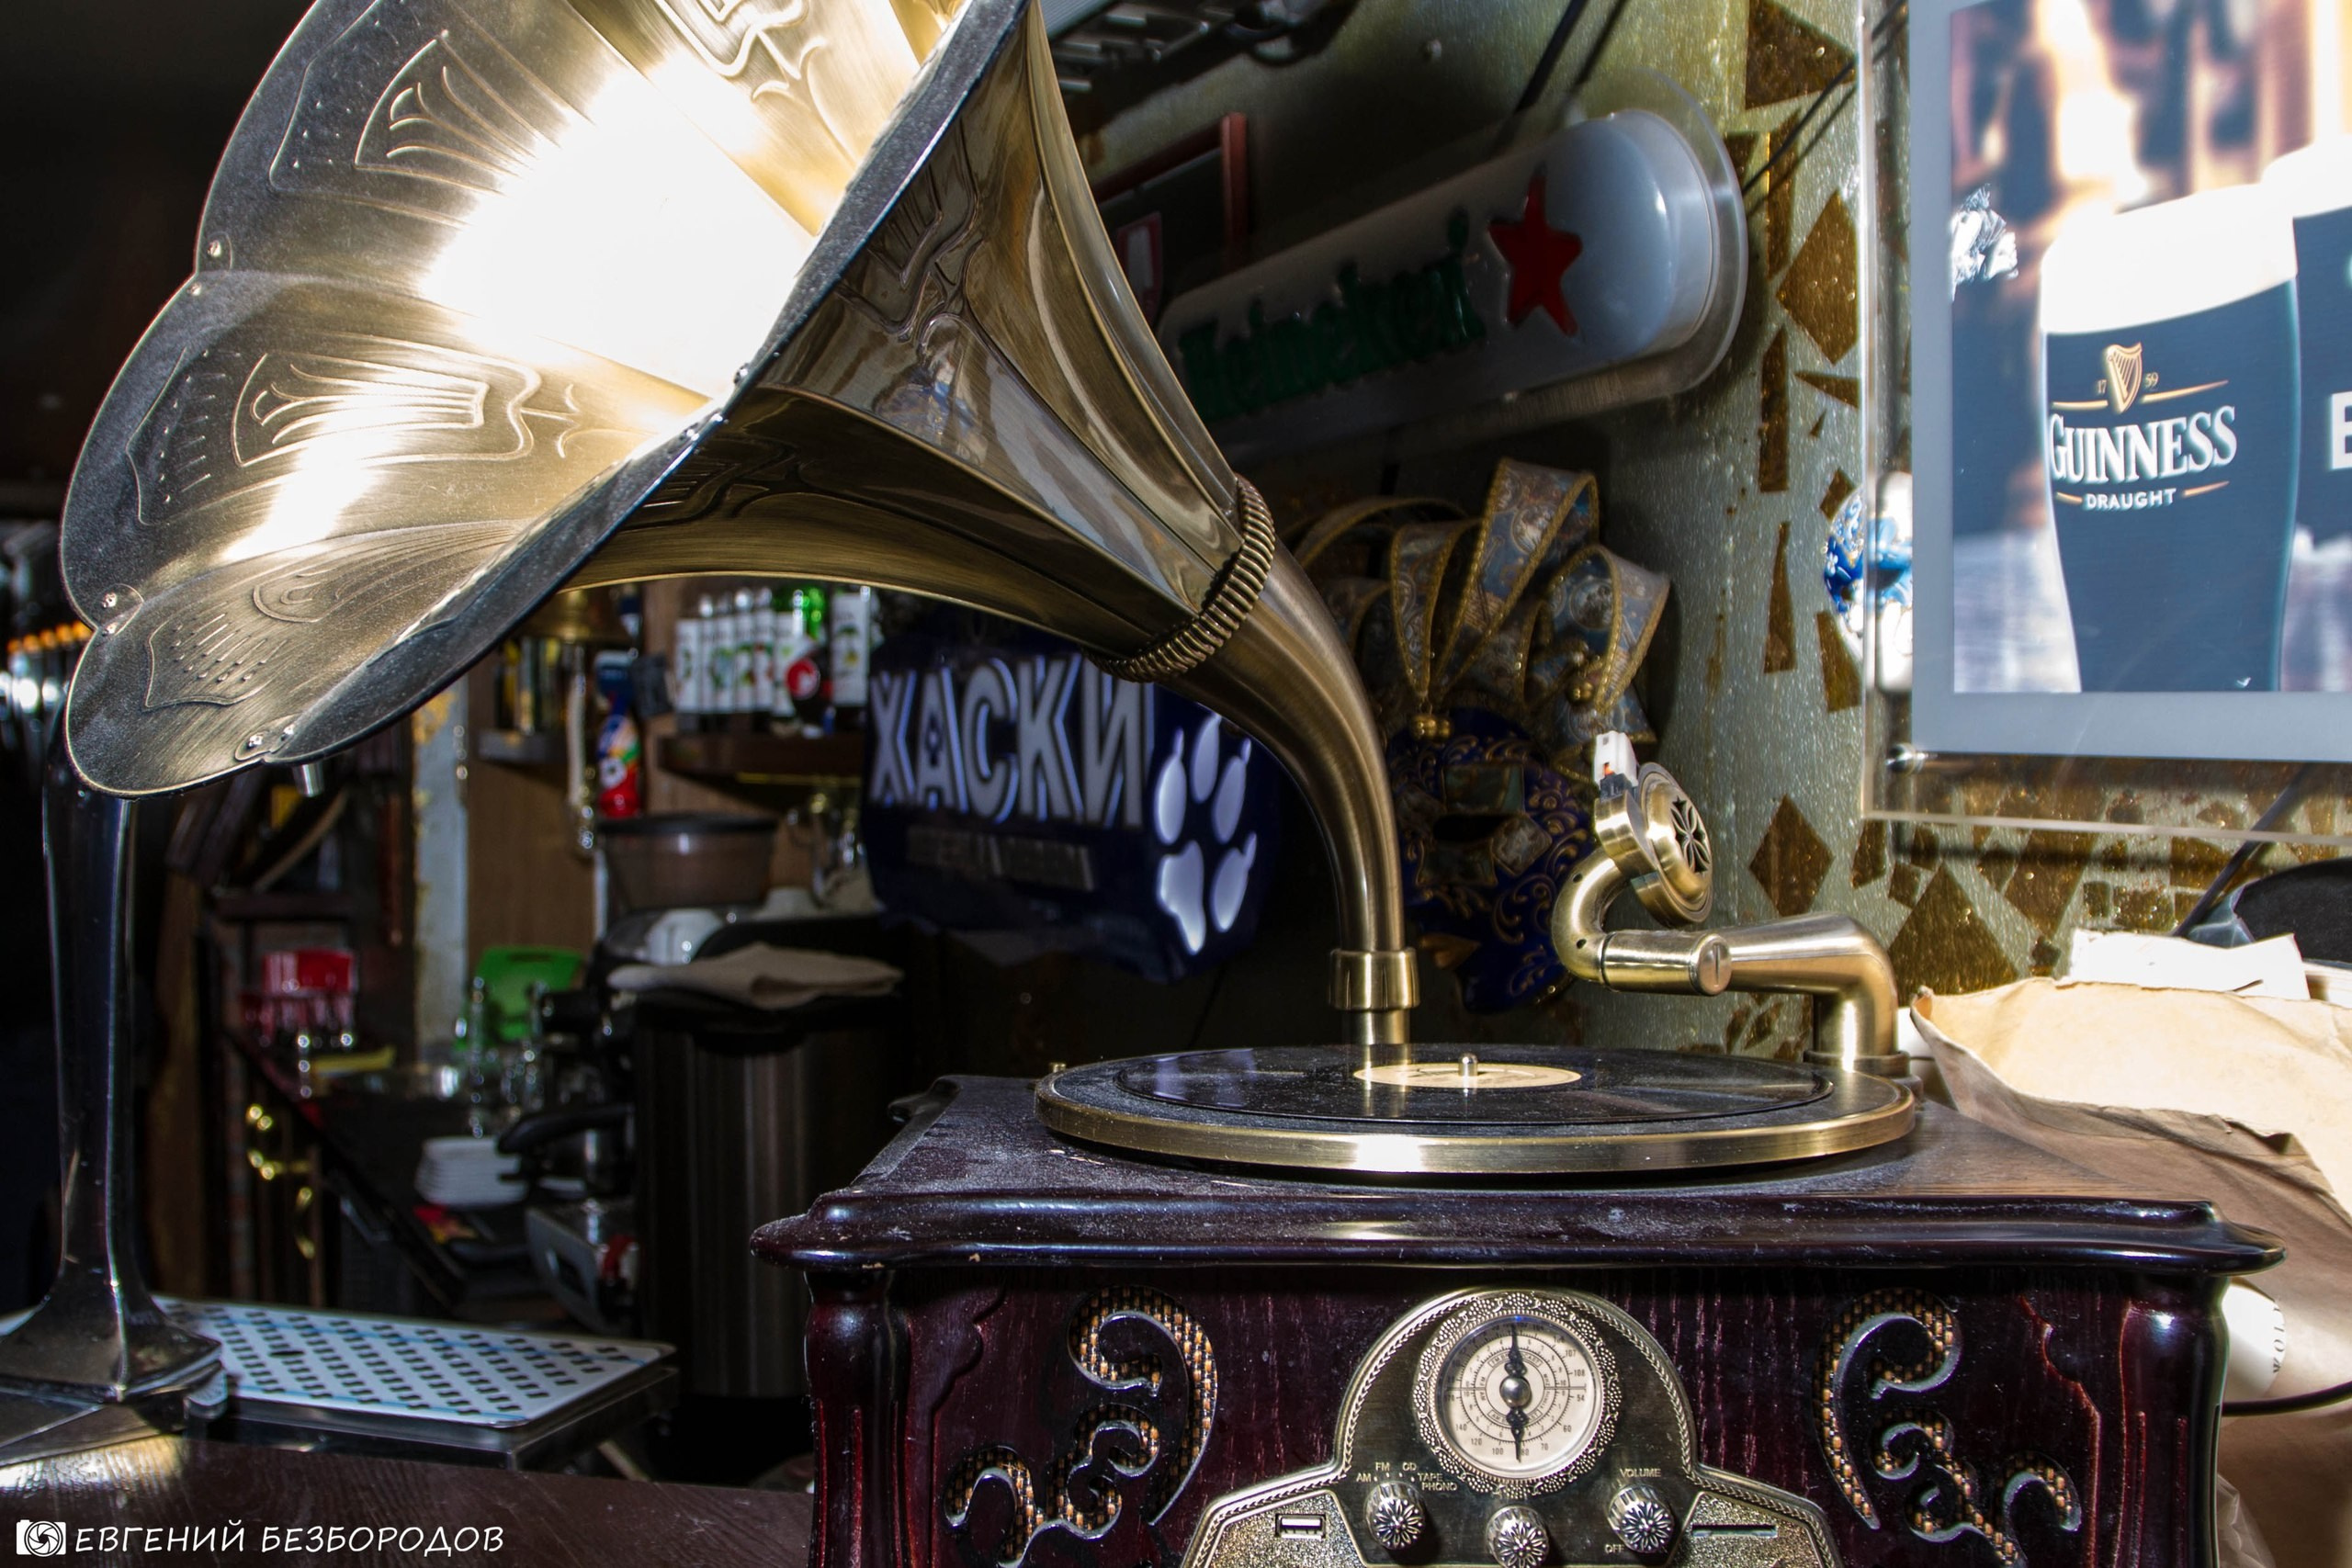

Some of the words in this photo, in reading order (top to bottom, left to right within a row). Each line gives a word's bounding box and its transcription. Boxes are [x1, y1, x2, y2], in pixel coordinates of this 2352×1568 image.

[1178, 213, 1486, 422] Heineken
[2097, 379, 2108, 394] 17
[2145, 372, 2159, 391] 59
[2049, 404, 2238, 484] GUINNESS
[2084, 488, 2177, 511] DRAUGHT
[869, 655, 1155, 829] ХАСКИ
[1574, 1369, 1586, 1377] 108
[1563, 1425, 1572, 1433] 60
[1374, 1461, 1391, 1472] FM
[1402, 1461, 1417, 1472] CD
[1355, 1472, 1372, 1483] AM
[1417, 1472, 1443, 1482] TAPE
[1620, 1468, 1662, 1478] VOLUME
[1421, 1482, 1458, 1492] PHONO
[1604, 1543, 1625, 1553] OFF
